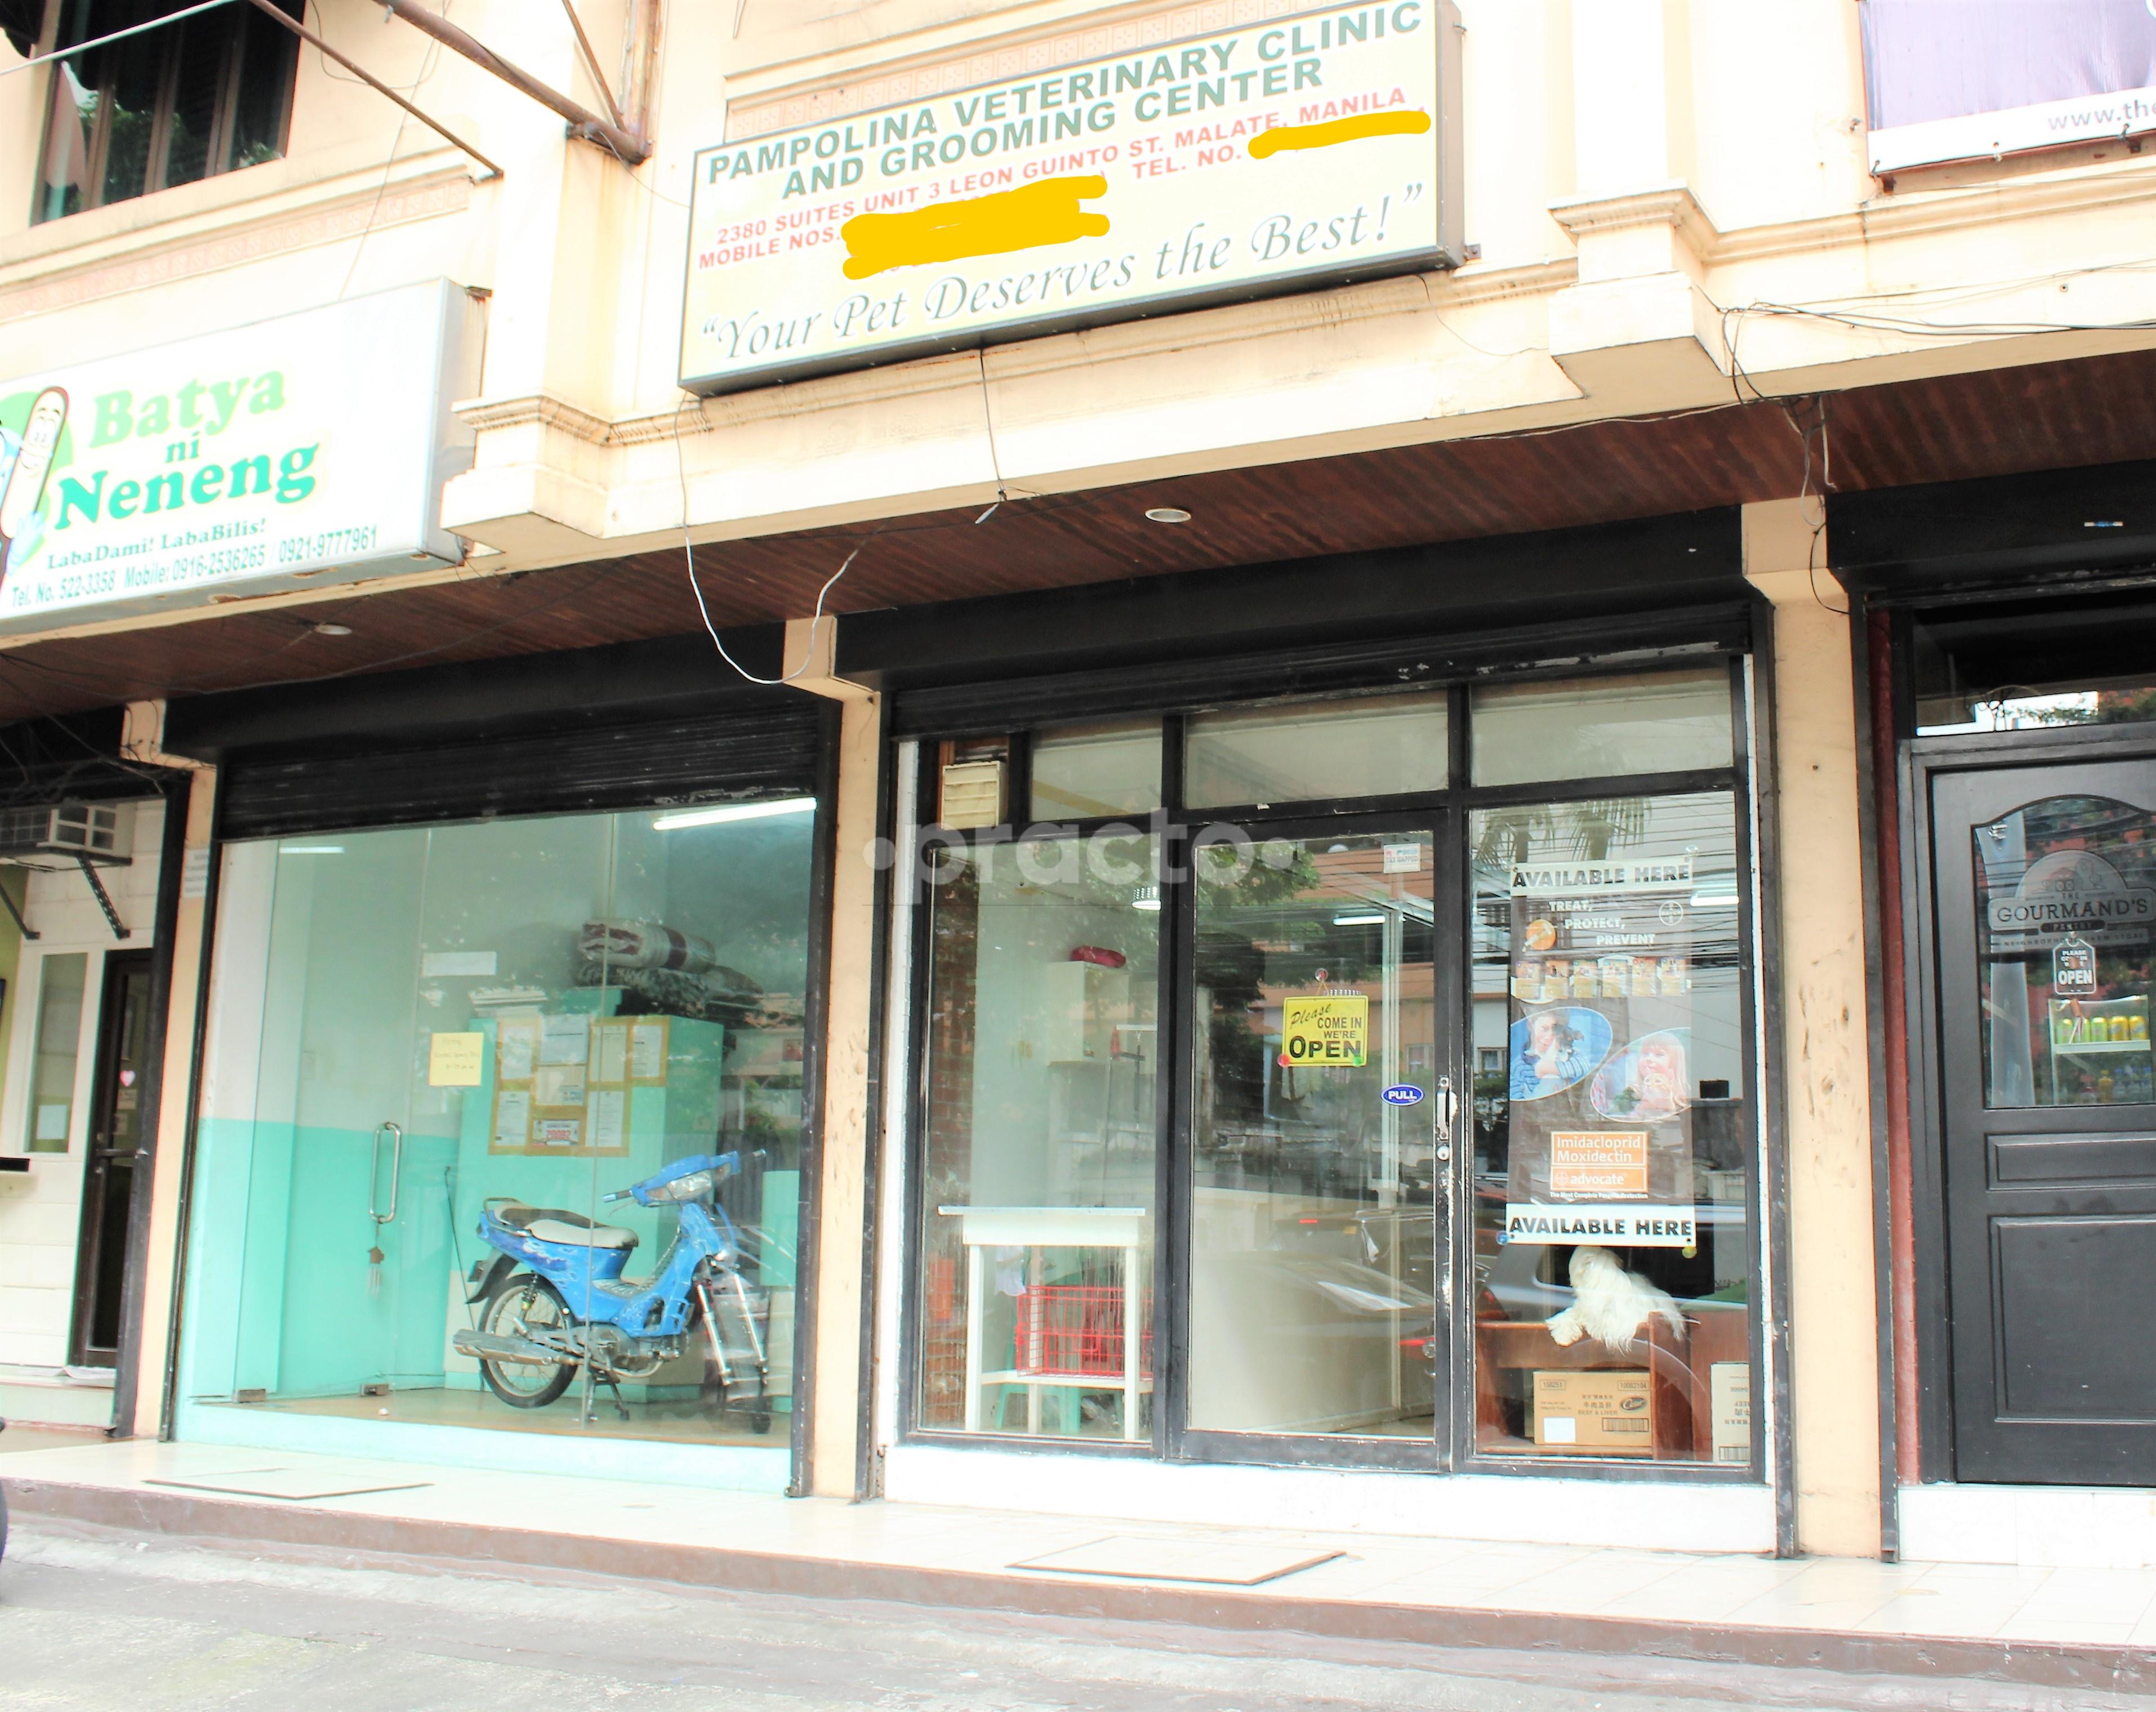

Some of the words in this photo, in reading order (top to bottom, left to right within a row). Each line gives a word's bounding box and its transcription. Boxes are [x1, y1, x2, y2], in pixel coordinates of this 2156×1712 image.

[709, 108, 938, 185] PAMPOLINA
[955, 39, 1239, 127] VETERINARY
[1257, 3, 1423, 62] CLINIC
[782, 157, 864, 200] AND
[880, 100, 1116, 178] GROOMING
[1134, 57, 1324, 123] CENTER
[716, 220, 767, 246] 2380
[775, 201, 856, 233] SUITES
[864, 186, 920, 213] UNIT
[928, 183, 941, 200] 3
[950, 167, 1014, 195] LEON
[1022, 145, 1119, 180] GUINTO
[1129, 137, 1164, 158] ST.
[1174, 112, 1289, 149] MALATE,
[1299, 87, 1407, 124] MANILA
[1132, 157, 1187, 180] TEL.
[1197, 147, 1241, 168] NO.
[699, 238, 781, 271] MOBILE
[789, 227, 841, 251] NOS.
[834, 291, 907, 338] Pet
[925, 253, 1135, 322] Deserves
[1156, 221, 1232, 280] the
[90, 369, 286, 449] Batya
[166, 431, 201, 465] ni
[54, 442, 321, 530] Neneng
[47, 537, 155, 570] LabaDami!
[161, 517, 266, 550] LabaBilis!
[11, 586, 31, 608] Tel.
[35, 582, 55, 604] No.
[59, 569, 116, 600] 522-3358
[124, 561, 170, 588] Mobile:
[1513, 868, 1625, 888] AVAILABLE
[1635, 864, 1690, 883] HERE
[1549, 899, 1593, 912] TREAT,
[1997, 898, 2149, 922] GOURMAND'S
[1564, 917, 1626, 930] PROTECT,
[1596, 933, 1656, 946] PREVENT
[2057, 969, 2093, 986] OPEN
[1290, 1004, 1331, 1029] Please
[1317, 1017, 1347, 1029] COME
[1351, 1017, 1362, 1029] IN
[1324, 1030, 1356, 1038] WE'RE
[1289, 1035, 1361, 1059] OPEN
[1388, 1090, 1418, 1100] PULL
[1557, 1135, 1641, 1151] Imidacloprid
[1557, 1149, 1632, 1163] Moxidectin
[1570, 1172, 1625, 1185] advocate
[1509, 1217, 1625, 1234] AVAILABLE
[1636, 1219, 1692, 1236] HERE
